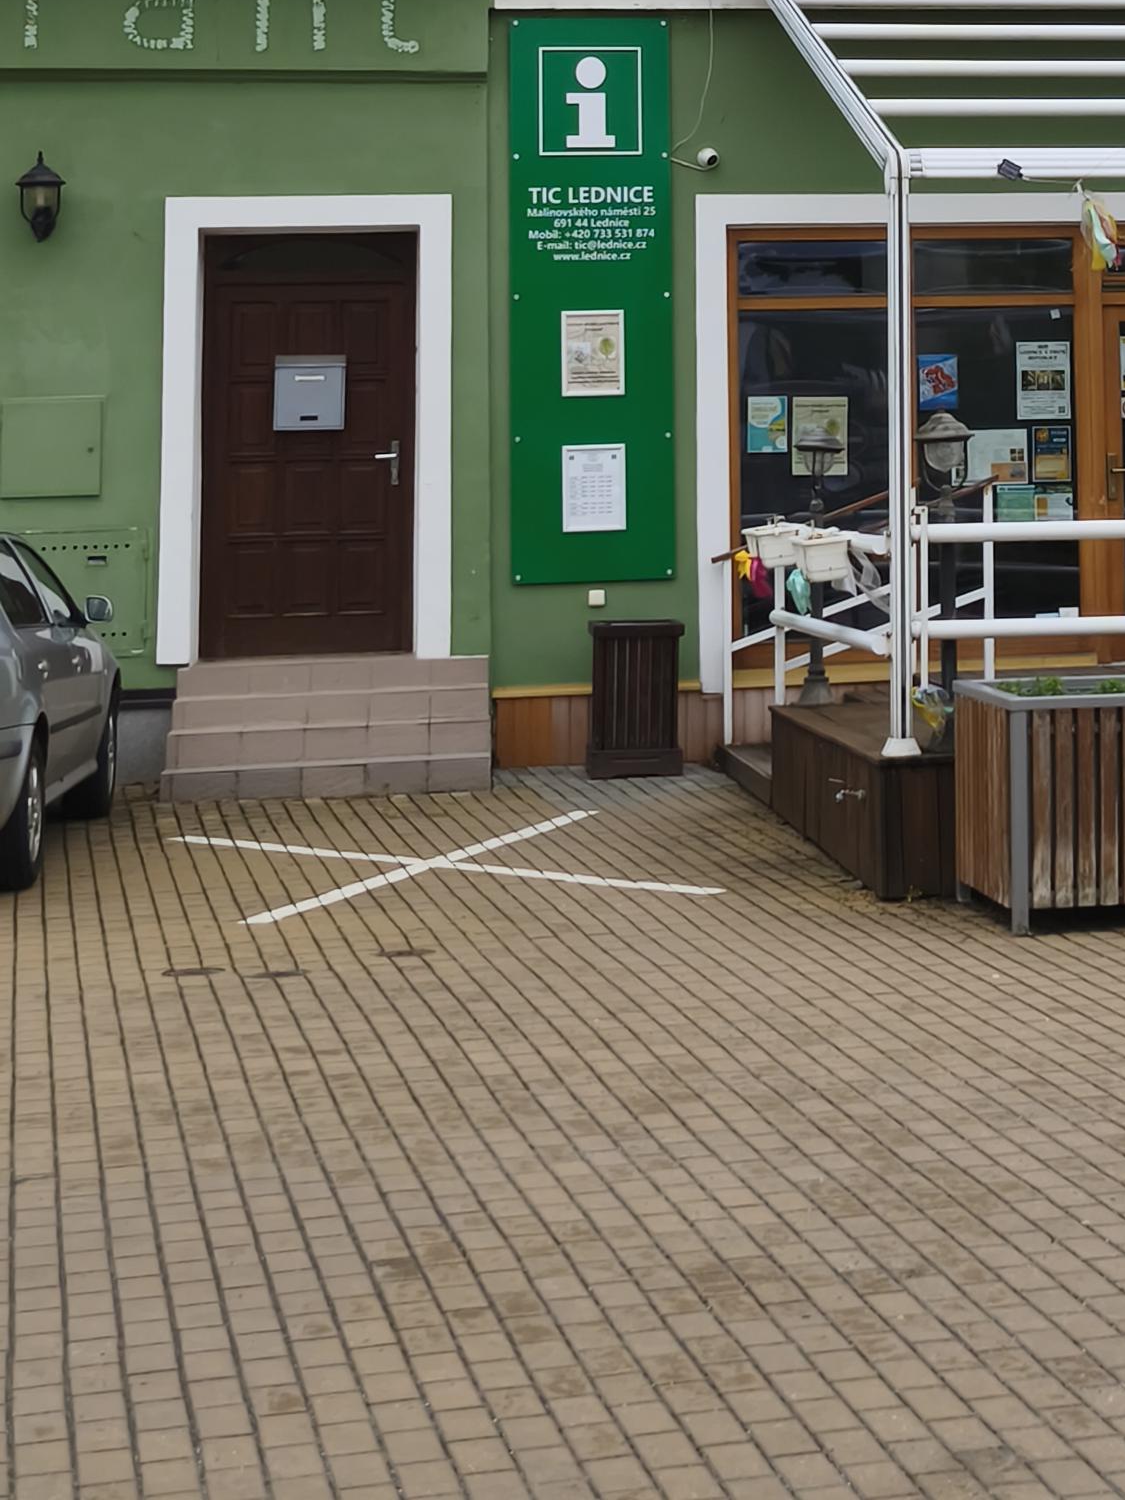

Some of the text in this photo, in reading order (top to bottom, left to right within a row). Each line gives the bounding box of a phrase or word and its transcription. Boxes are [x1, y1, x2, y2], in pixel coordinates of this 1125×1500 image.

[528, 186, 655, 204] TIC LEDNICE
[527, 207, 599, 217] Malinovského
[643, 206, 656, 216] 25
[553, 217, 630, 228] 691 44 Lednice
[528, 228, 655, 239] Mobil: +420 733 531 874
[536, 240, 647, 250] E-mail: tic@lednice.cz
[553, 251, 631, 260] www.lednice.cz
